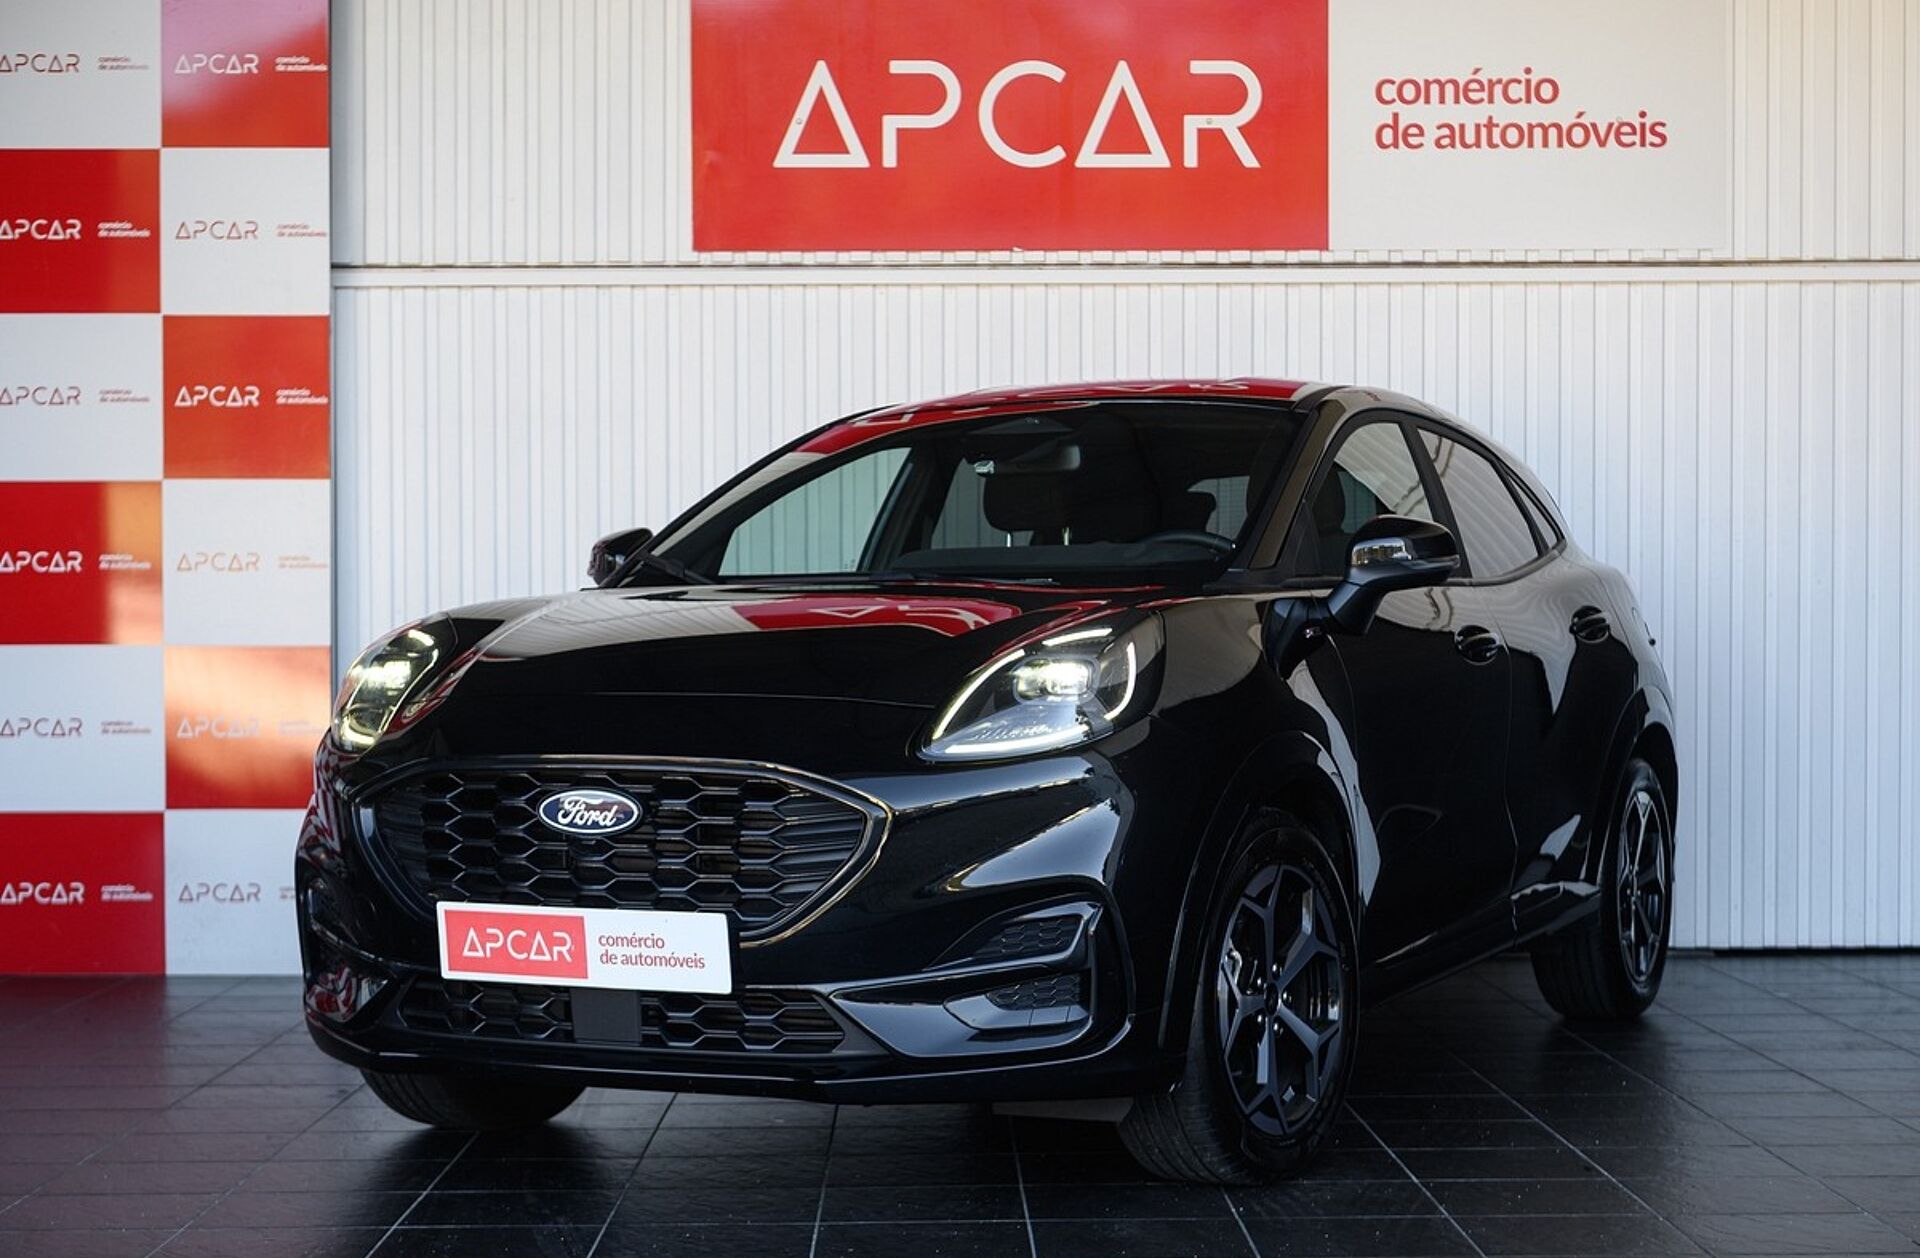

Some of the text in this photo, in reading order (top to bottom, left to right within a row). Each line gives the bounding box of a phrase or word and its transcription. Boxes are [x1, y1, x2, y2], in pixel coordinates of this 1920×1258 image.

[0, 53, 80, 73] APCAR
[174, 53, 259, 74] APCAR
[1375, 67, 1561, 106] comércio
[773, 60, 1263, 169] APCAR
[1375, 110, 1669, 151] de automóveis
[0, 218, 82, 240] APCAR
[175, 220, 259, 240] APCAR
[0, 386, 82, 406] APCAR
[174, 385, 260, 407] APCAR
[0, 551, 83, 573] APCAR
[176, 552, 261, 573] APCAR
[0, 717, 83, 738] APCAR
[176, 716, 260, 738] APCAR
[557, 796, 619, 827] Ford
[1, 881, 85, 904] APCAR
[179, 882, 262, 903] APCAR
[462, 927, 574, 963] APCAR
[598, 932, 666, 949] comércio
[600, 949, 706, 969] de automóveis
